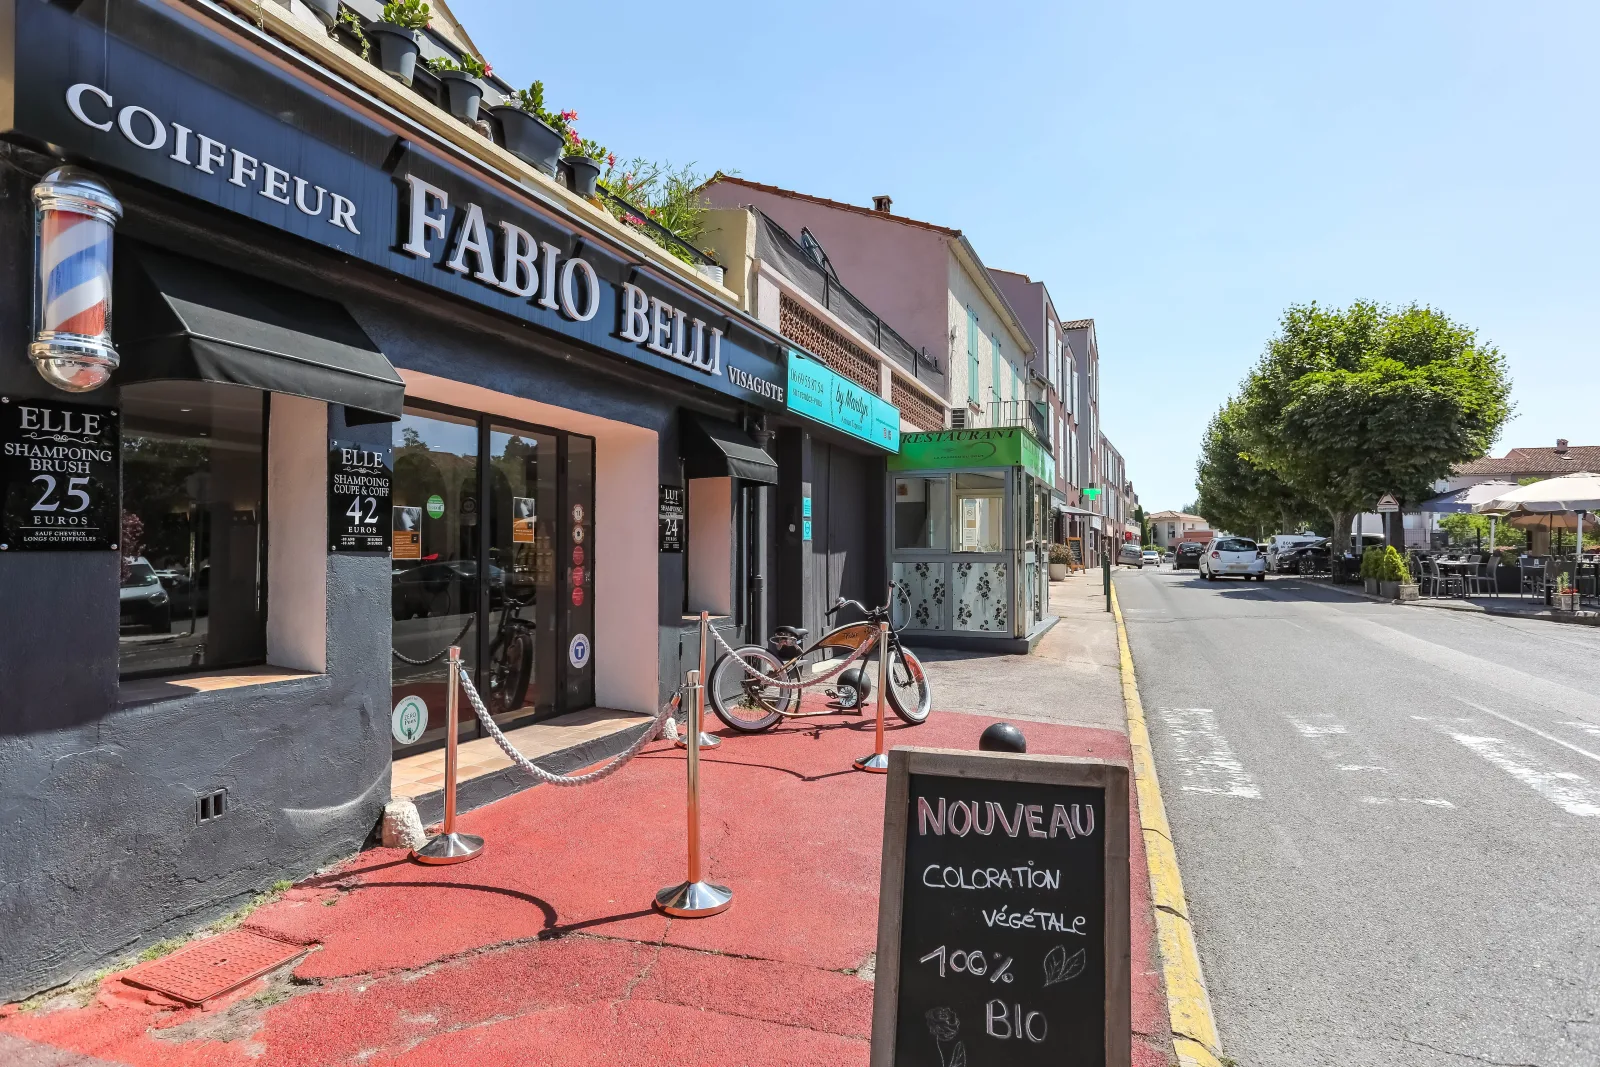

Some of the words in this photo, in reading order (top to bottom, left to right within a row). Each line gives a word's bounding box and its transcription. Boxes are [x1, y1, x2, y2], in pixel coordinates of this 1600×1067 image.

[65, 83, 361, 235] COIFFEUR
[402, 173, 600, 322] FABIO
[620, 282, 724, 376] BELLI
[727, 364, 784, 403] VISAGISTE
[836, 382, 844, 414] by
[18, 406, 102, 436] ELLE
[902, 428, 1016, 444] RESTAURANT
[4, 442, 112, 462] SHAMPOING
[341, 448, 384, 468] ELLE
[30, 458, 91, 474] BRUSH
[334, 474, 390, 487] SHAMPOING
[334, 484, 360, 495] COUPE
[361, 486, 368, 496] &
[369, 486, 390, 496] COIFF
[30, 474, 90, 513] 25
[665, 489, 678, 500] LUI
[34, 516, 88, 525] EUROS
[346, 496, 379, 525] 42
[665, 518, 678, 536] 24
[918, 796, 1095, 840] NOUVEAU
[986, 999, 1048, 1043] BIO
